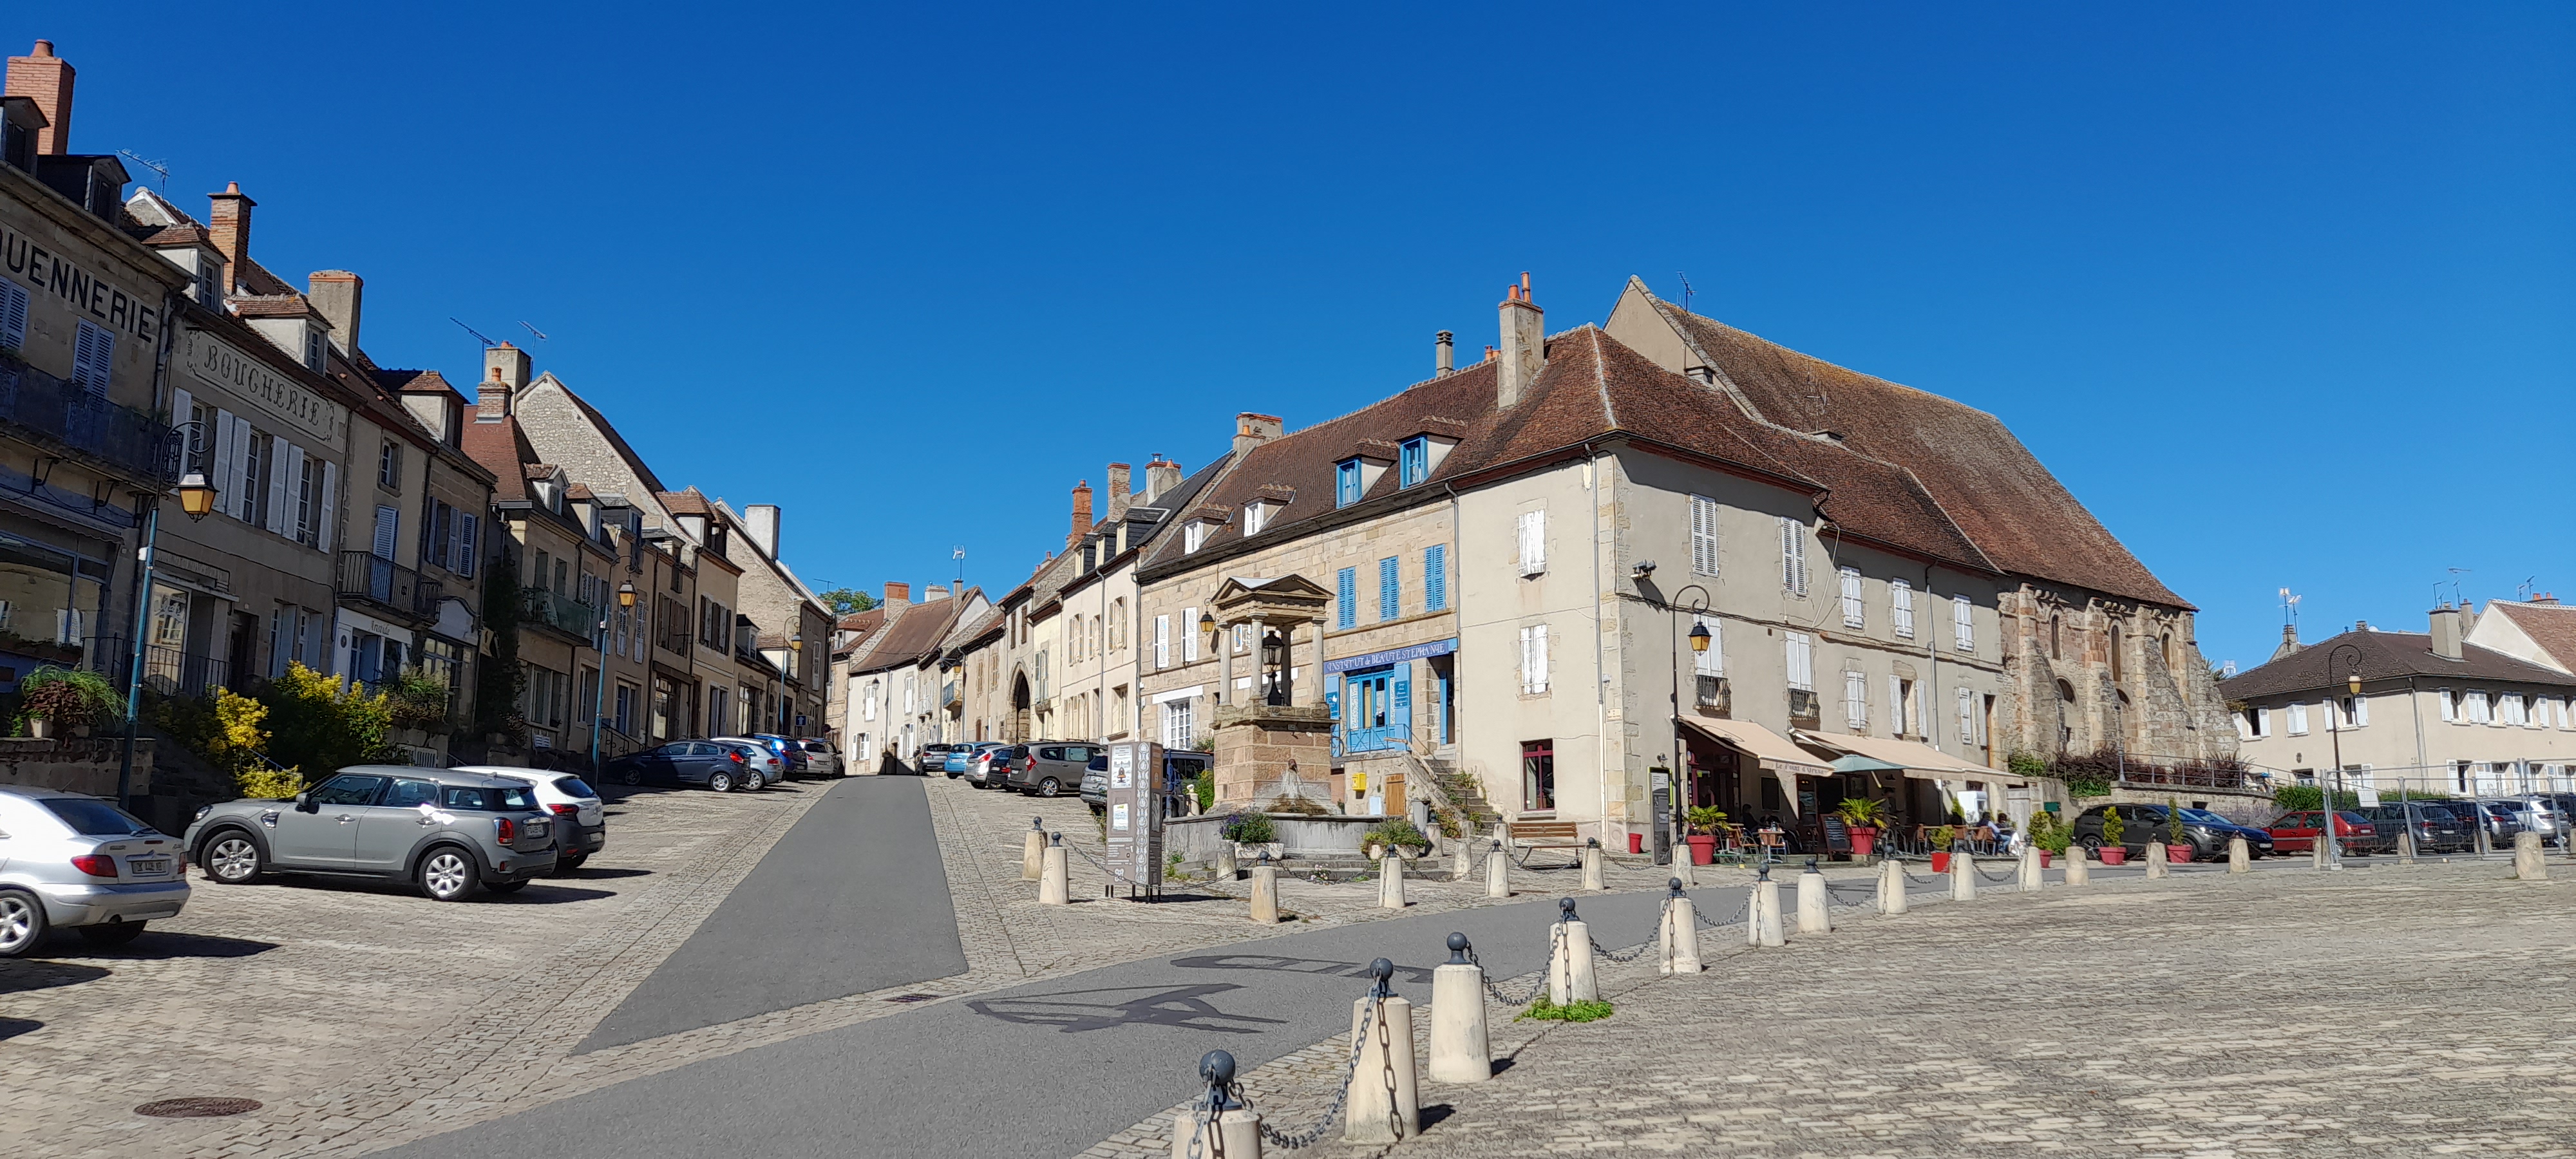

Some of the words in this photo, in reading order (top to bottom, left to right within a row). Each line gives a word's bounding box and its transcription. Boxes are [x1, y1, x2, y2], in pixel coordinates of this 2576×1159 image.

[0, 228, 155, 344] UENNERIE
[204, 344, 319, 426] BOUCHERIE
[1327, 657, 1364, 672] INSTITUT
[1401, 643, 1446, 659] STEPHANIE
